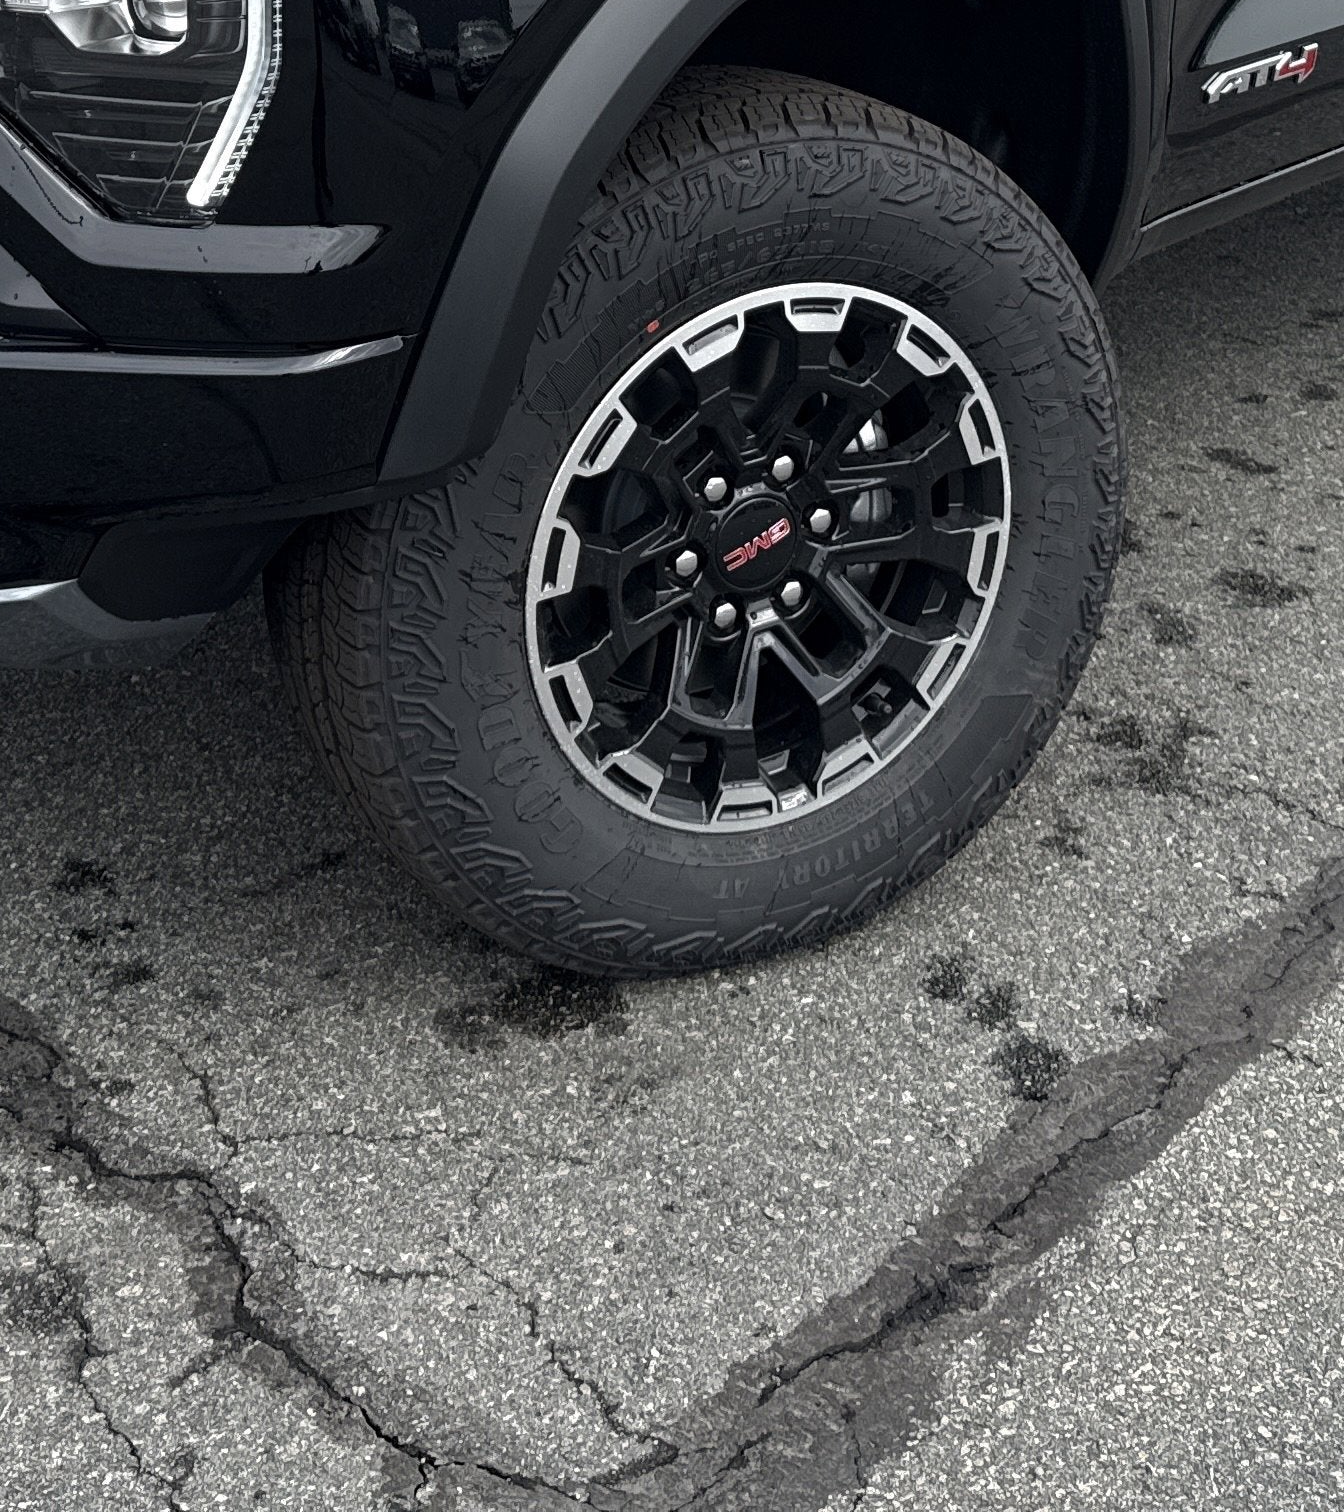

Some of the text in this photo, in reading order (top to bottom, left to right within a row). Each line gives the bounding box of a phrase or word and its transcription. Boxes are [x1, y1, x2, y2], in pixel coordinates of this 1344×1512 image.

[1201, 42, 1319, 104] AT4
[984, 294, 1080, 661] WRANGLER
[723, 518, 791, 572] GMC
[777, 791, 935, 890] TERRITORY
[712, 877, 751, 900] AT
